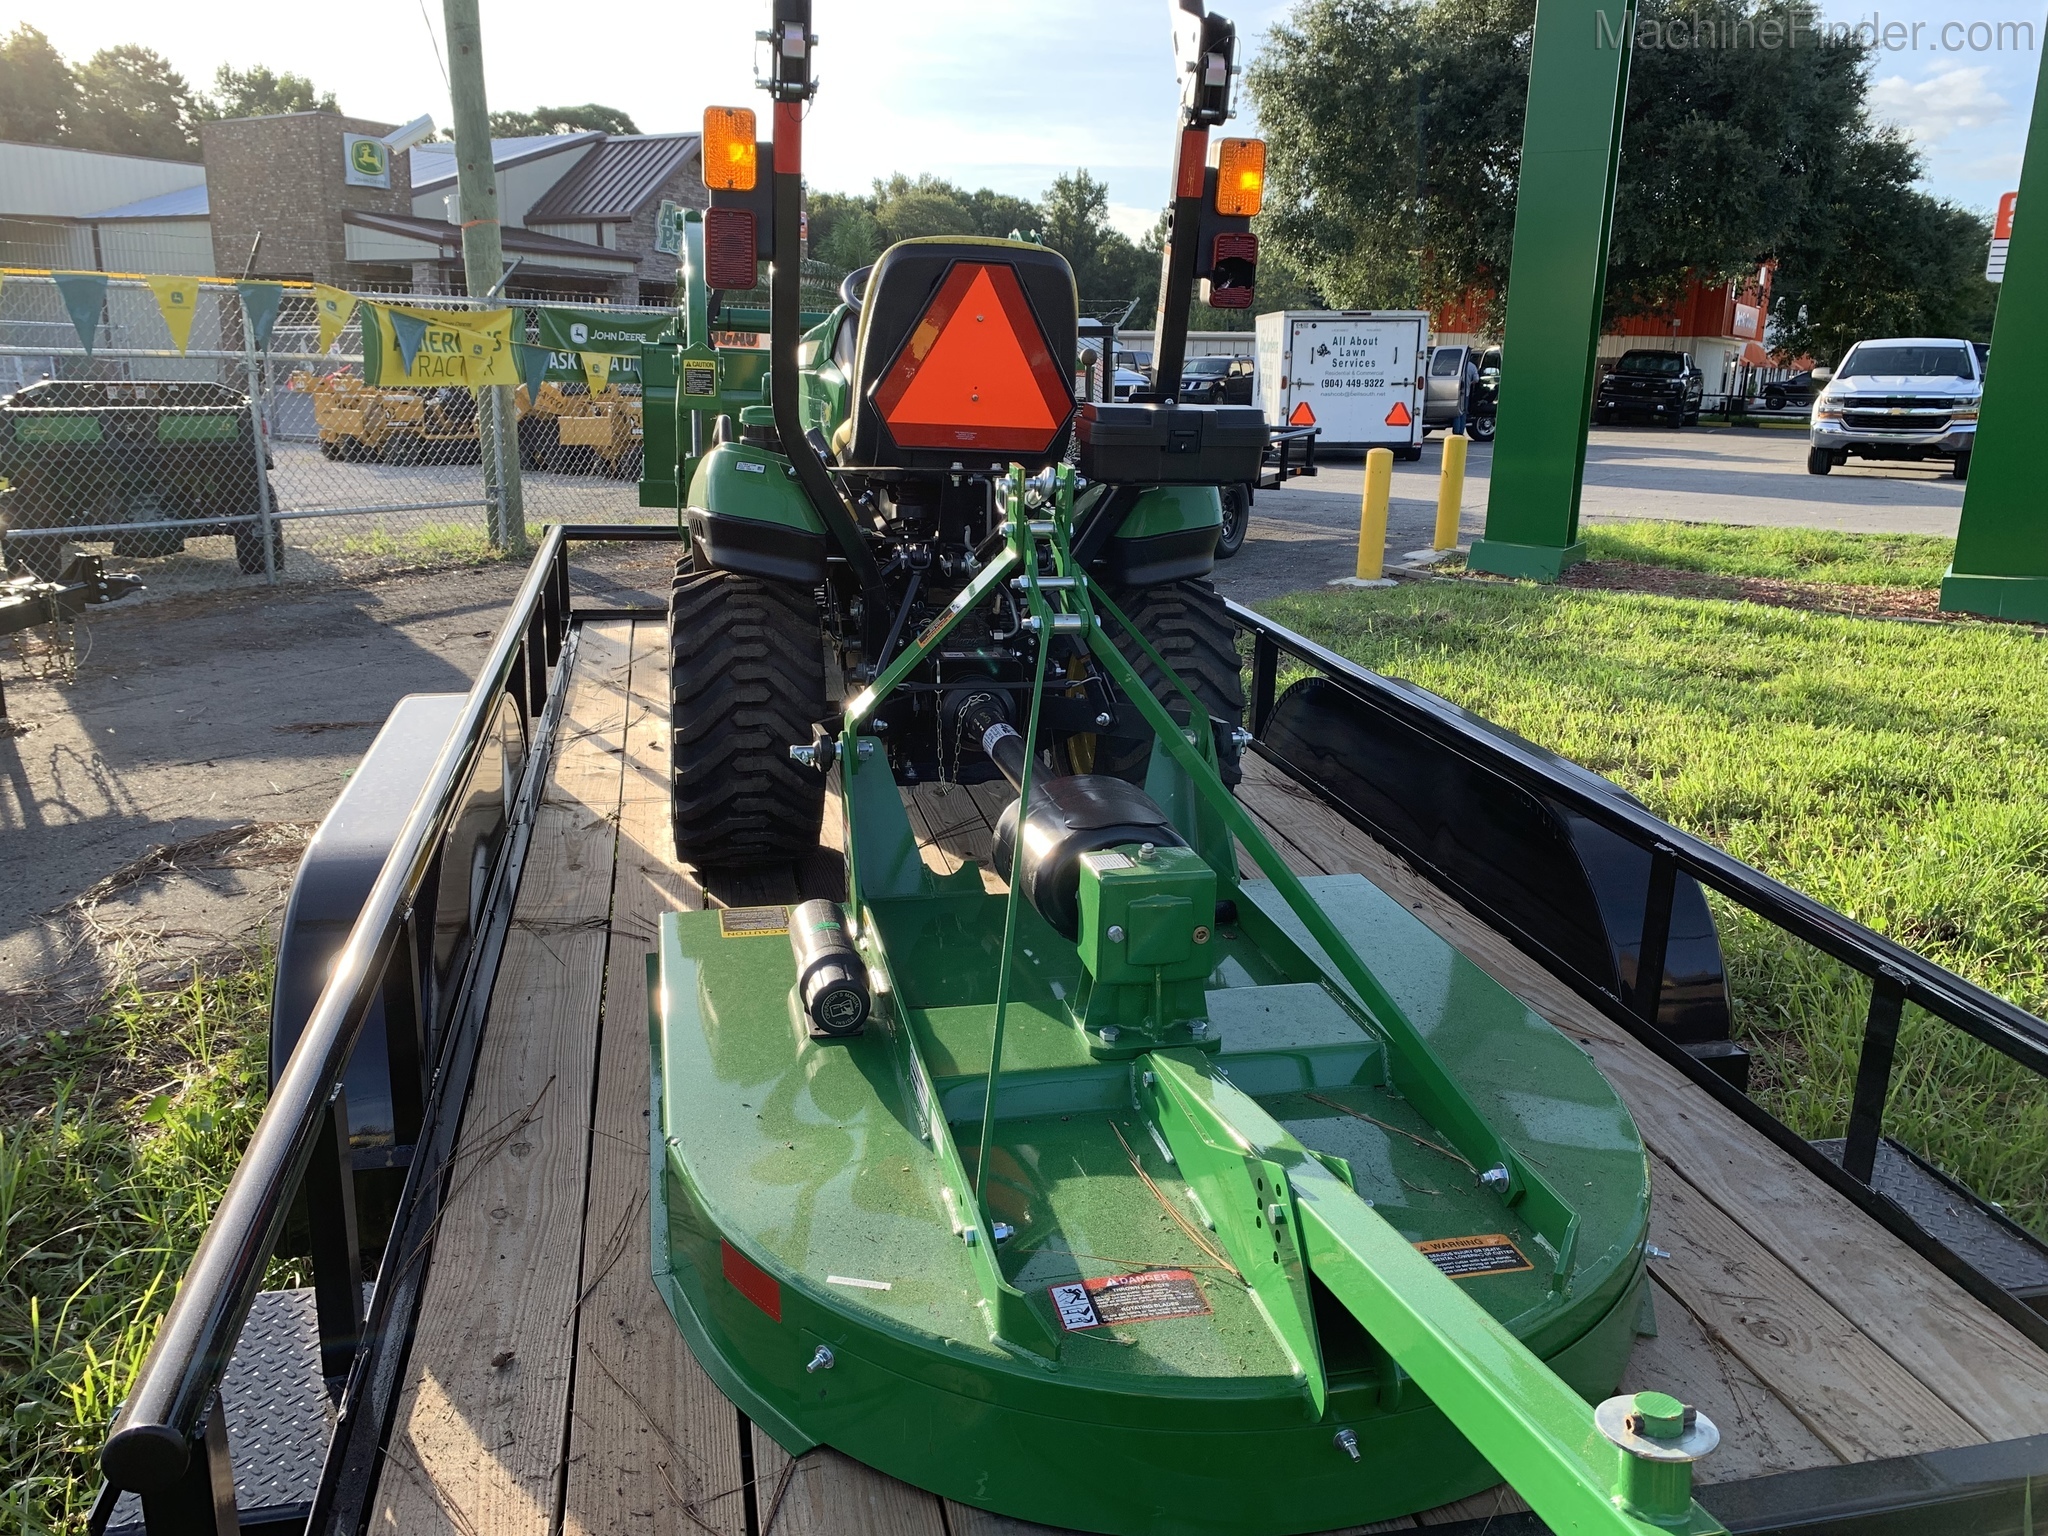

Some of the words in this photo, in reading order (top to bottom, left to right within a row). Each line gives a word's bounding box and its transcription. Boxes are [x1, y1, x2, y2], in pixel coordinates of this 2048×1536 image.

[590, 329, 617, 341] JOHN
[618, 331, 646, 342] DEERE
[1332, 336, 1345, 346] All
[1350, 336, 1378, 346] About
[1339, 347, 1366, 357] Lawn
[549, 351, 577, 370] ASK
[1332, 358, 1376, 368] Services
[1321, 379, 1343, 388] (904)
[1346, 379, 1385, 388] 449-9322
[1430, 1238, 1484, 1250] WARNING
[1119, 1273, 1170, 1285] DANGER
